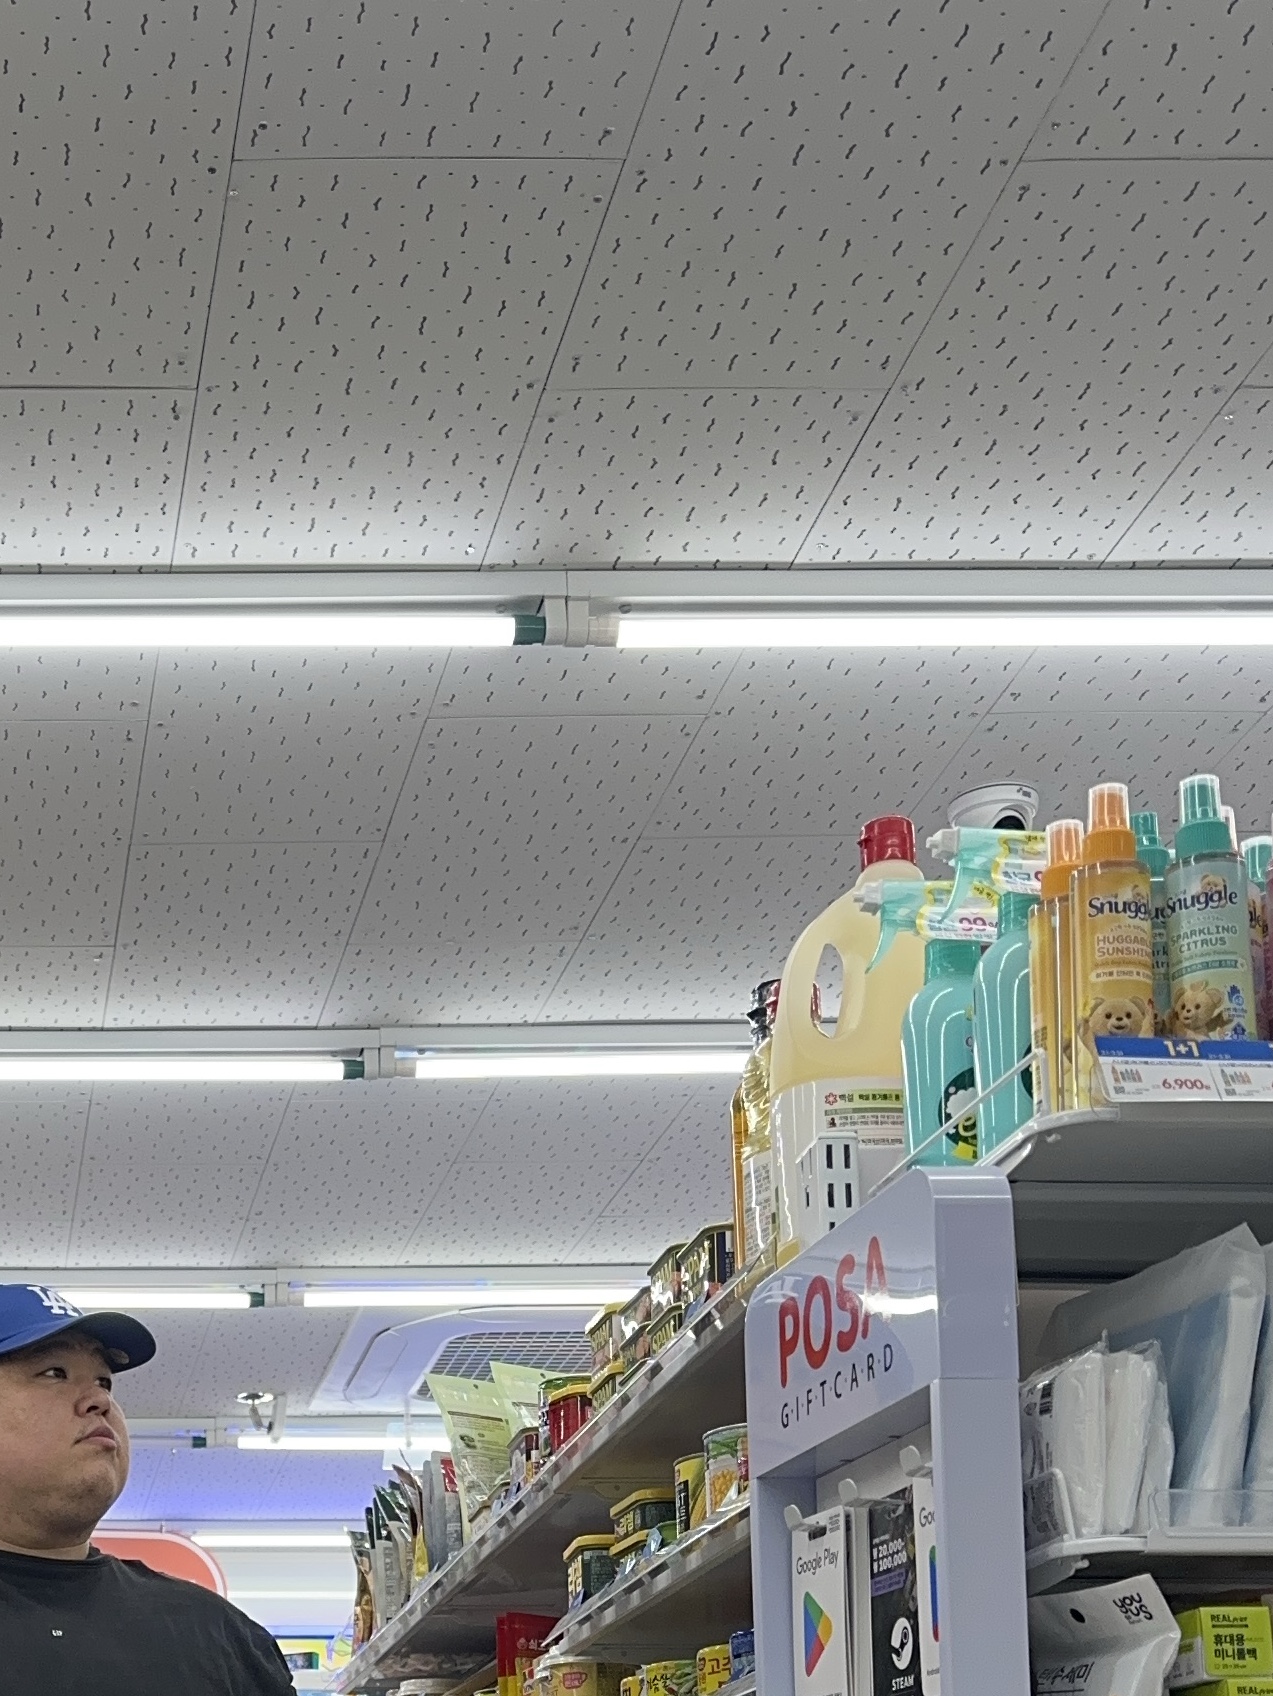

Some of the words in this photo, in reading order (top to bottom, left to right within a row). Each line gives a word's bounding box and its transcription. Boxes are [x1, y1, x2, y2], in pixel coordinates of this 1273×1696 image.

[1166, 884, 1239, 920] Snuggle
[1169, 924, 1238, 948] SPARKLING
[1178, 935, 1228, 954] CITRUS
[1163, 1040, 1201, 1058] 1+1
[26, 1286, 80, 1317] LA
[779, 1235, 889, 1390] POSA
[796, 1552, 823, 1576] Google
[823, 1548, 840, 1569] Play
[1210, 1614, 1232, 1623] REAL
[1213, 1633, 1245, 1647] 휴대용
[891, 1674, 915, 1692] STEAM
